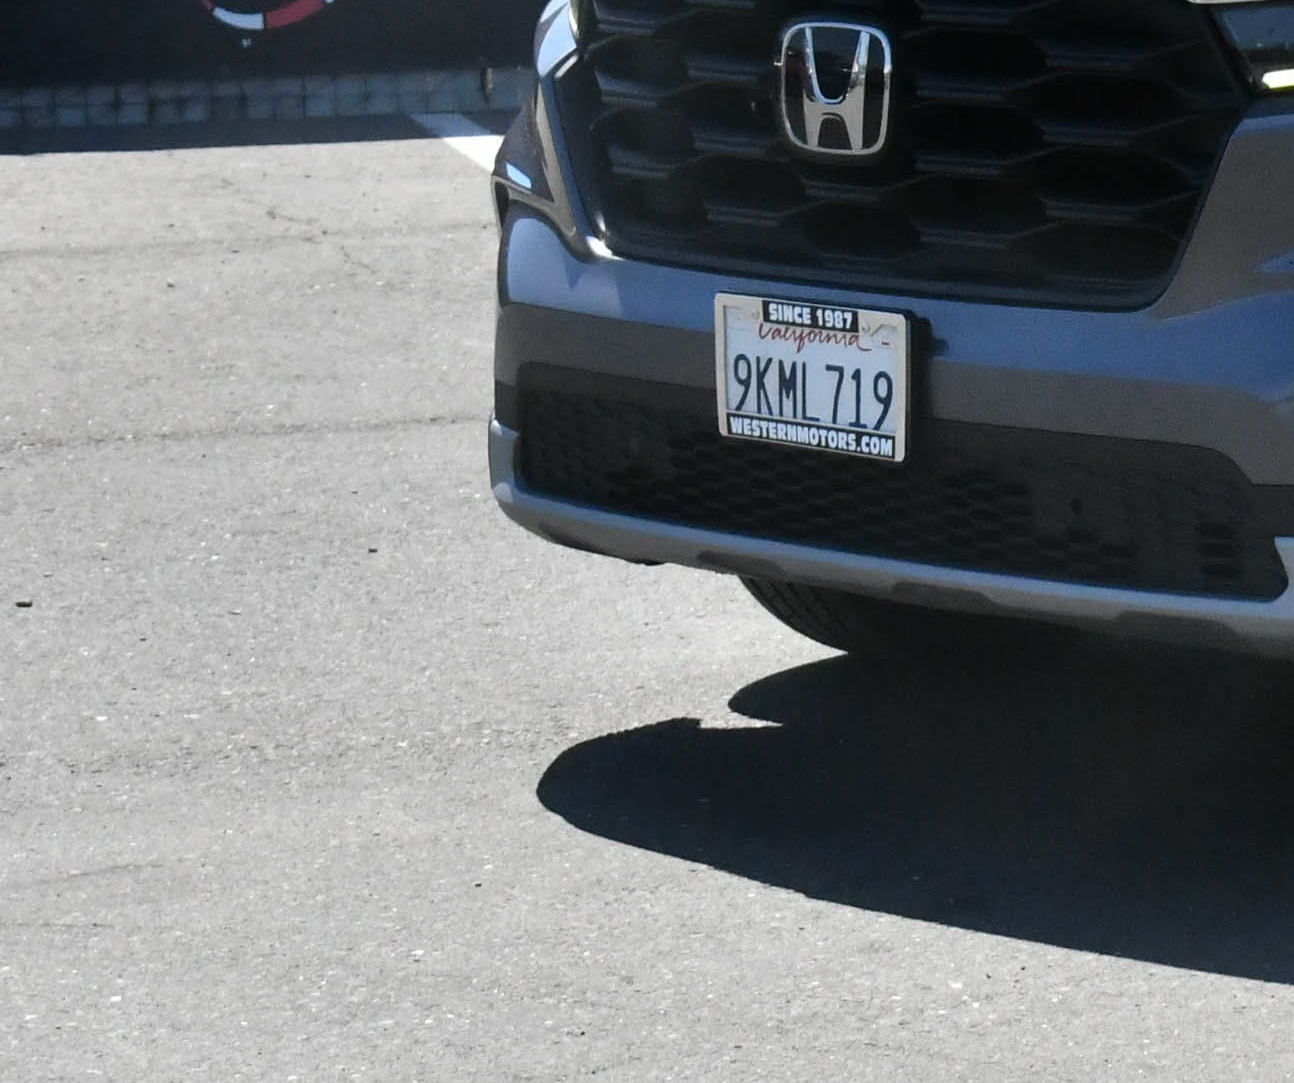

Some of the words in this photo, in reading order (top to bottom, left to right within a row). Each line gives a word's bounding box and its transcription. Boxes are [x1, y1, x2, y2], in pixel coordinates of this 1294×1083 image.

[768, 302, 811, 324] SINCE
[816, 309, 854, 330] 1987
[730, 416, 893, 456] WESTERNMOTORS.COM
